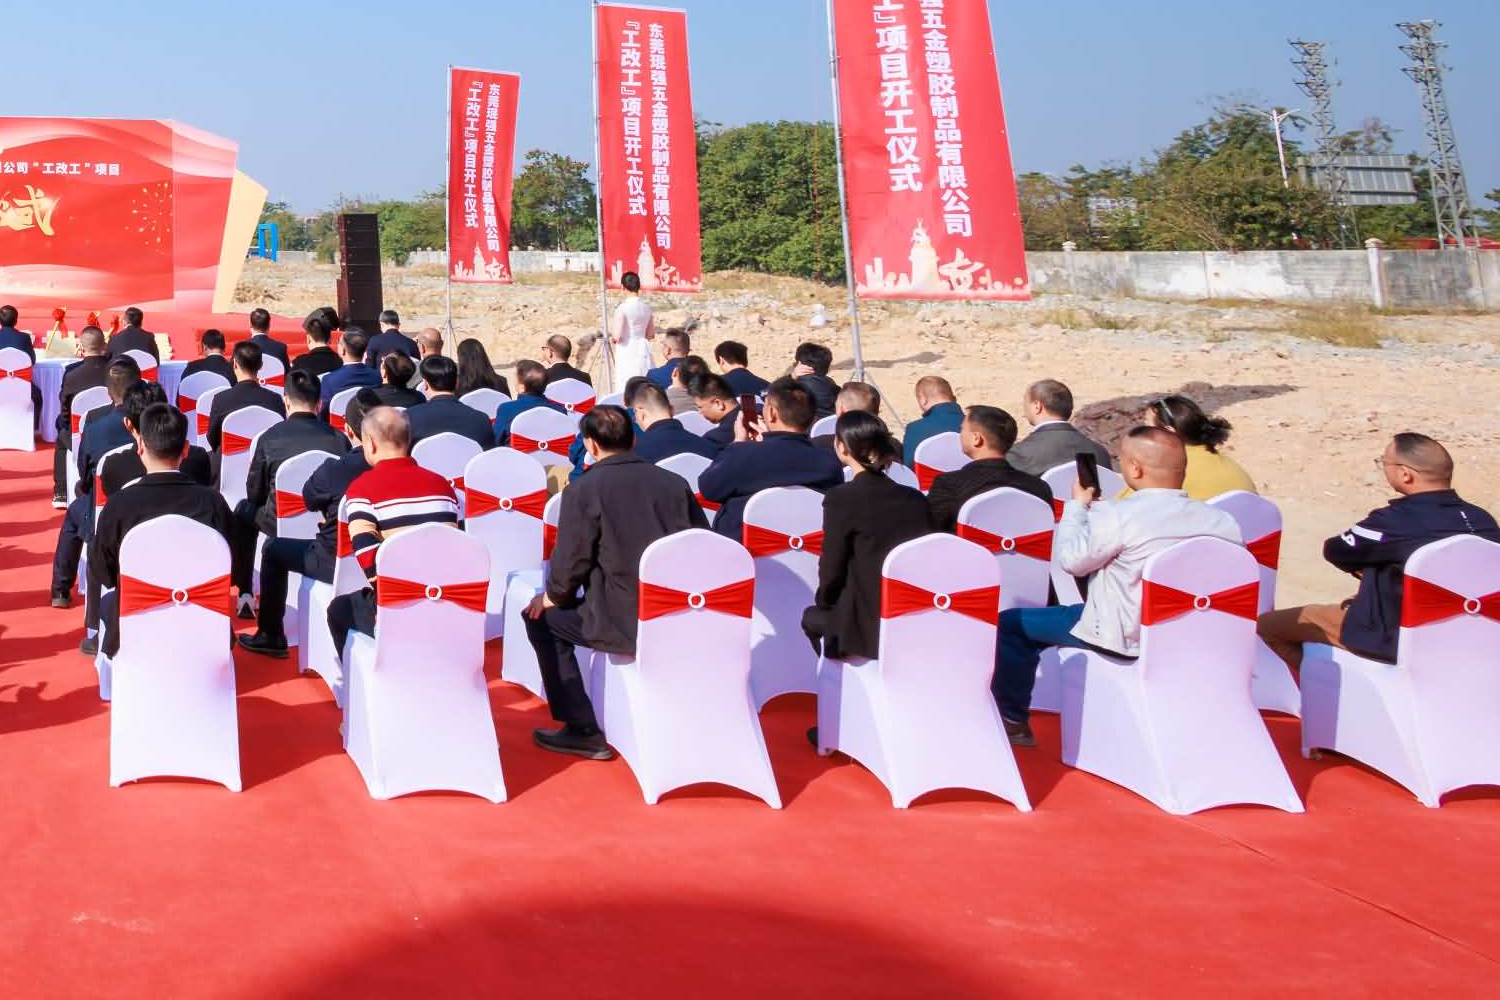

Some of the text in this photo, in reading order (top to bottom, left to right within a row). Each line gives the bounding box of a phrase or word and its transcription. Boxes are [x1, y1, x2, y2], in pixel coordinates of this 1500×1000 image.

[648, 23, 671, 249] 东莞珉强五金塑胶制品有限公司
